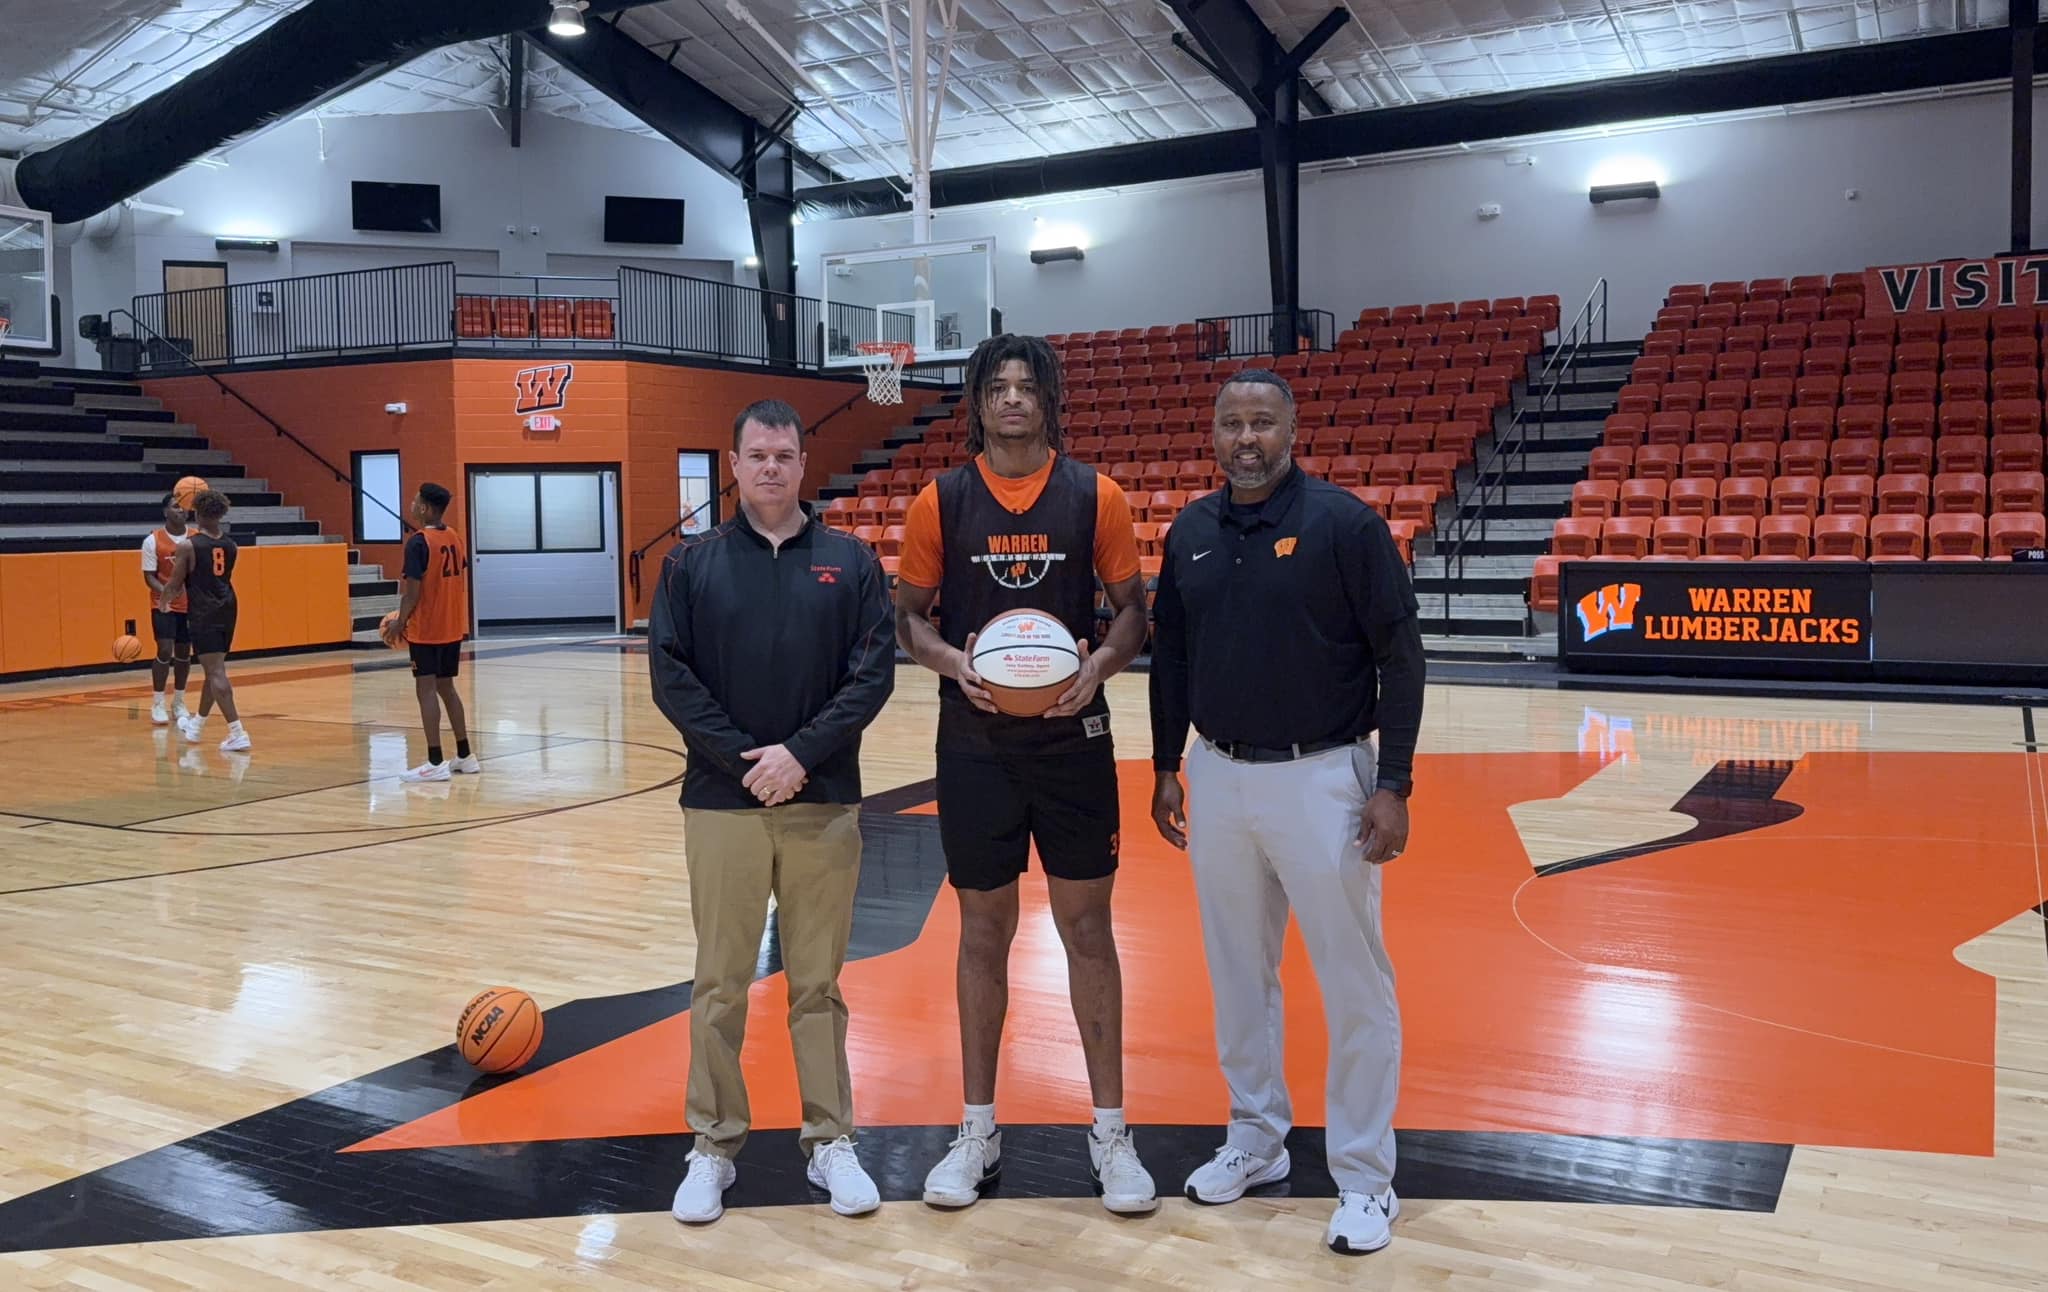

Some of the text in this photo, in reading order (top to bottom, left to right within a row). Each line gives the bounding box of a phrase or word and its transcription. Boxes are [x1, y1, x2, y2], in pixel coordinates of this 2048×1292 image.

[534, 416, 552, 429] EXIT
[988, 534, 1048, 554] WARREN
[212, 547, 225, 577] 8
[440, 544, 460, 577] 21
[1577, 583, 1642, 642] W
[1688, 587, 1812, 614] WARREN
[1644, 615, 1860, 644] LUMBERJACKS
[470, 1006, 505, 1046] NCAA
